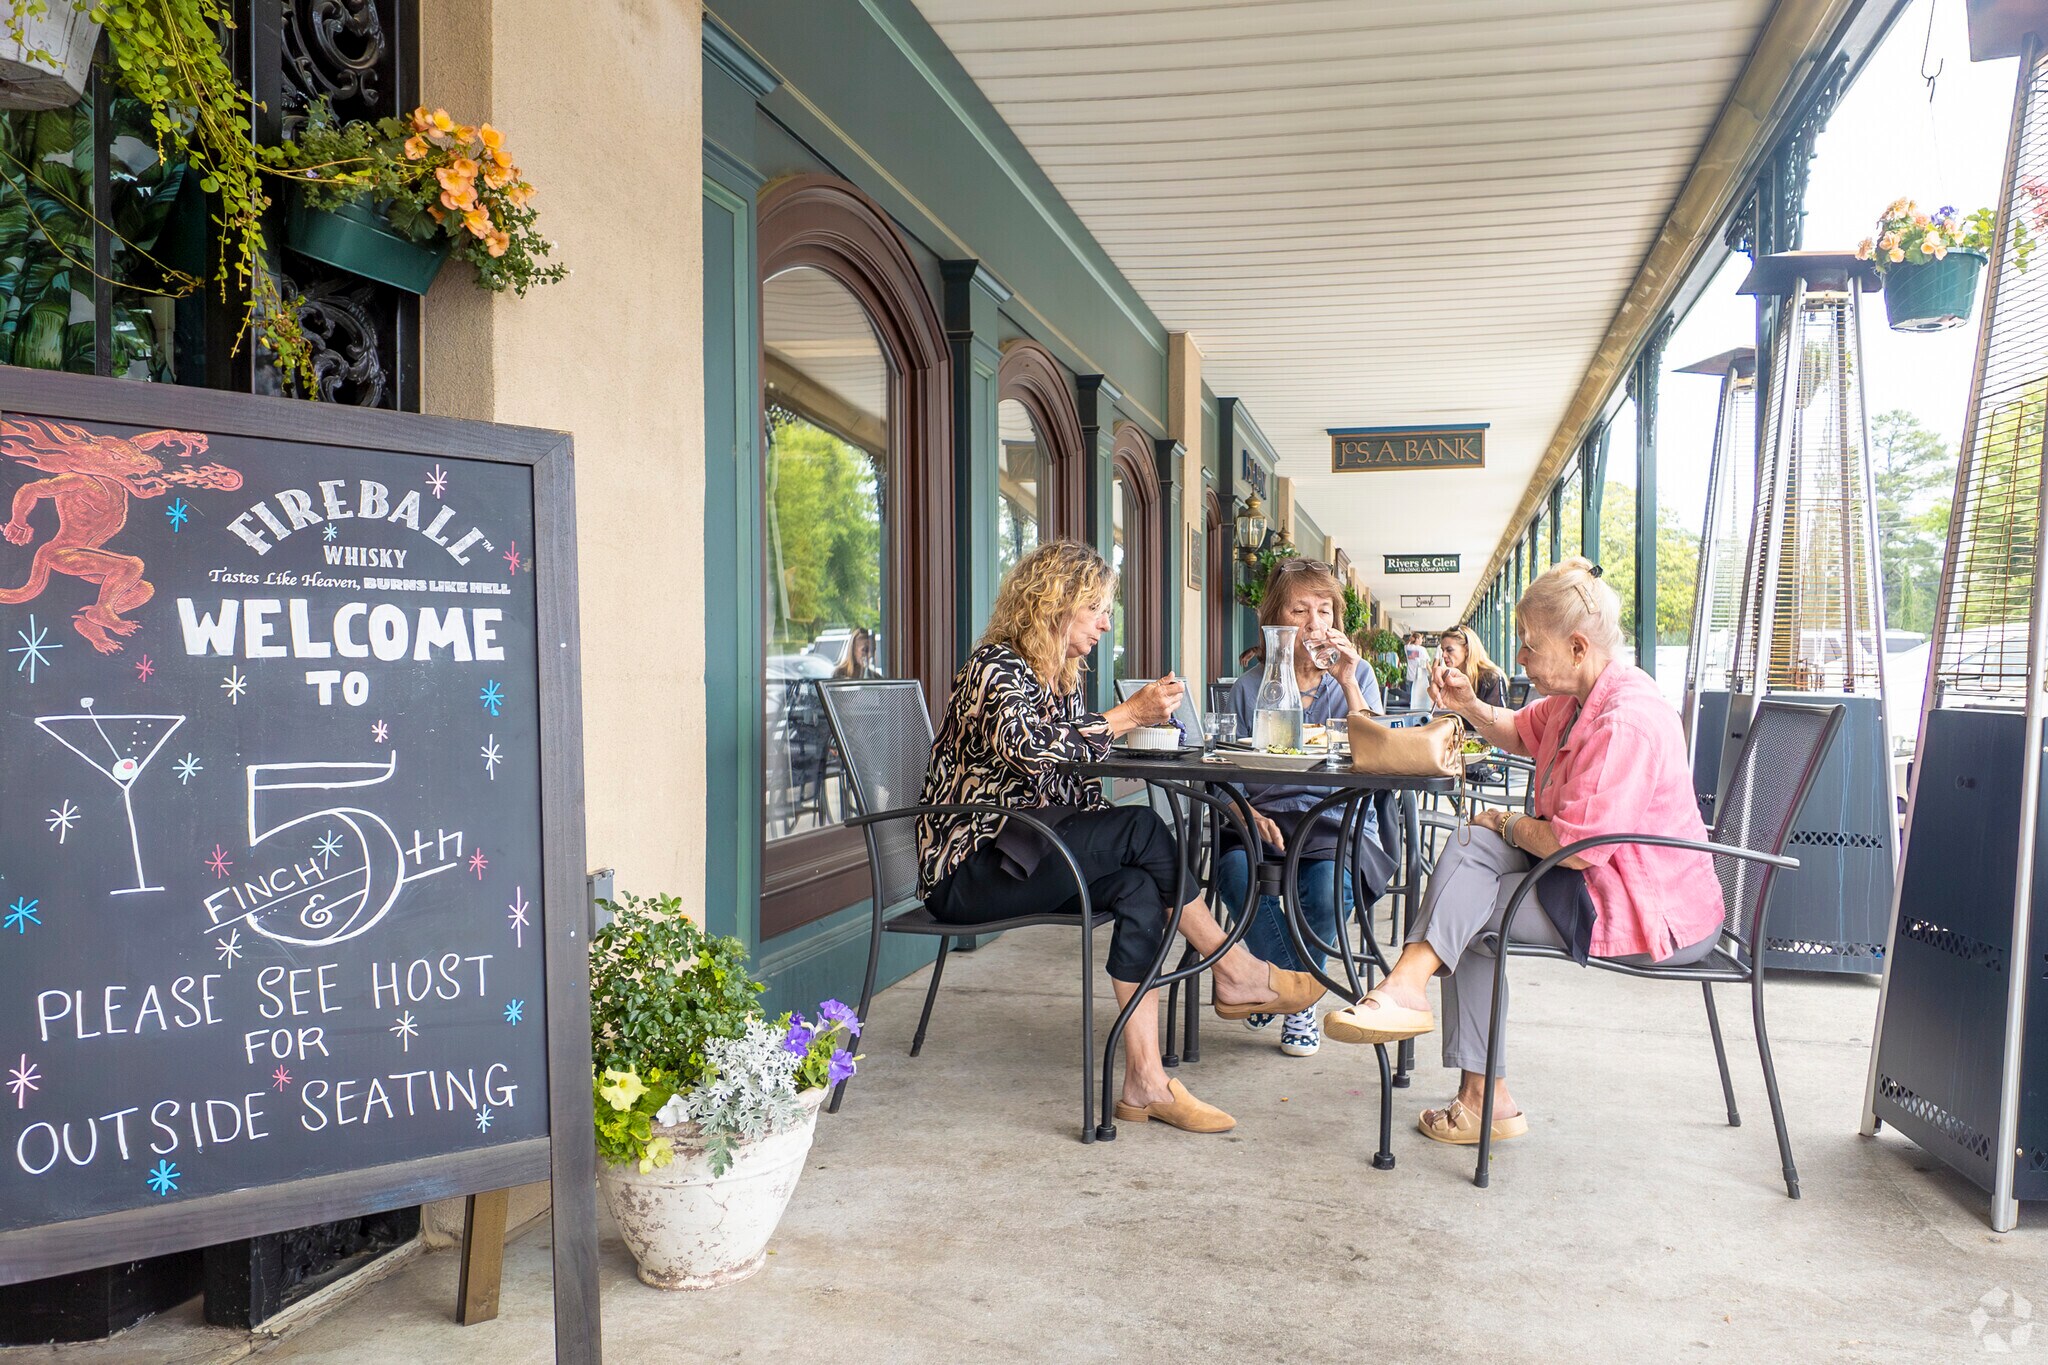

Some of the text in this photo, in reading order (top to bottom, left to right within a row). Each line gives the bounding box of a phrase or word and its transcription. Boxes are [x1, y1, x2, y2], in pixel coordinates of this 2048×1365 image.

[1404, 437, 1480, 462] BANK
[323, 545, 407, 568] WHISKY
[1388, 558, 1457, 568] Rivers & Glen
[208, 567, 511, 594] Tastes Like Heaven, BURNS LIKE HELL
[176, 597, 505, 661] WELCOME
[305, 671, 369, 706] TO
[203, 857, 325, 924] FINCH
[37, 953, 494, 1041] PLEASE SEE HOST
[245, 1027, 329, 1064] FOR
[16, 1062, 519, 1175] OUTSIDE SEATING
